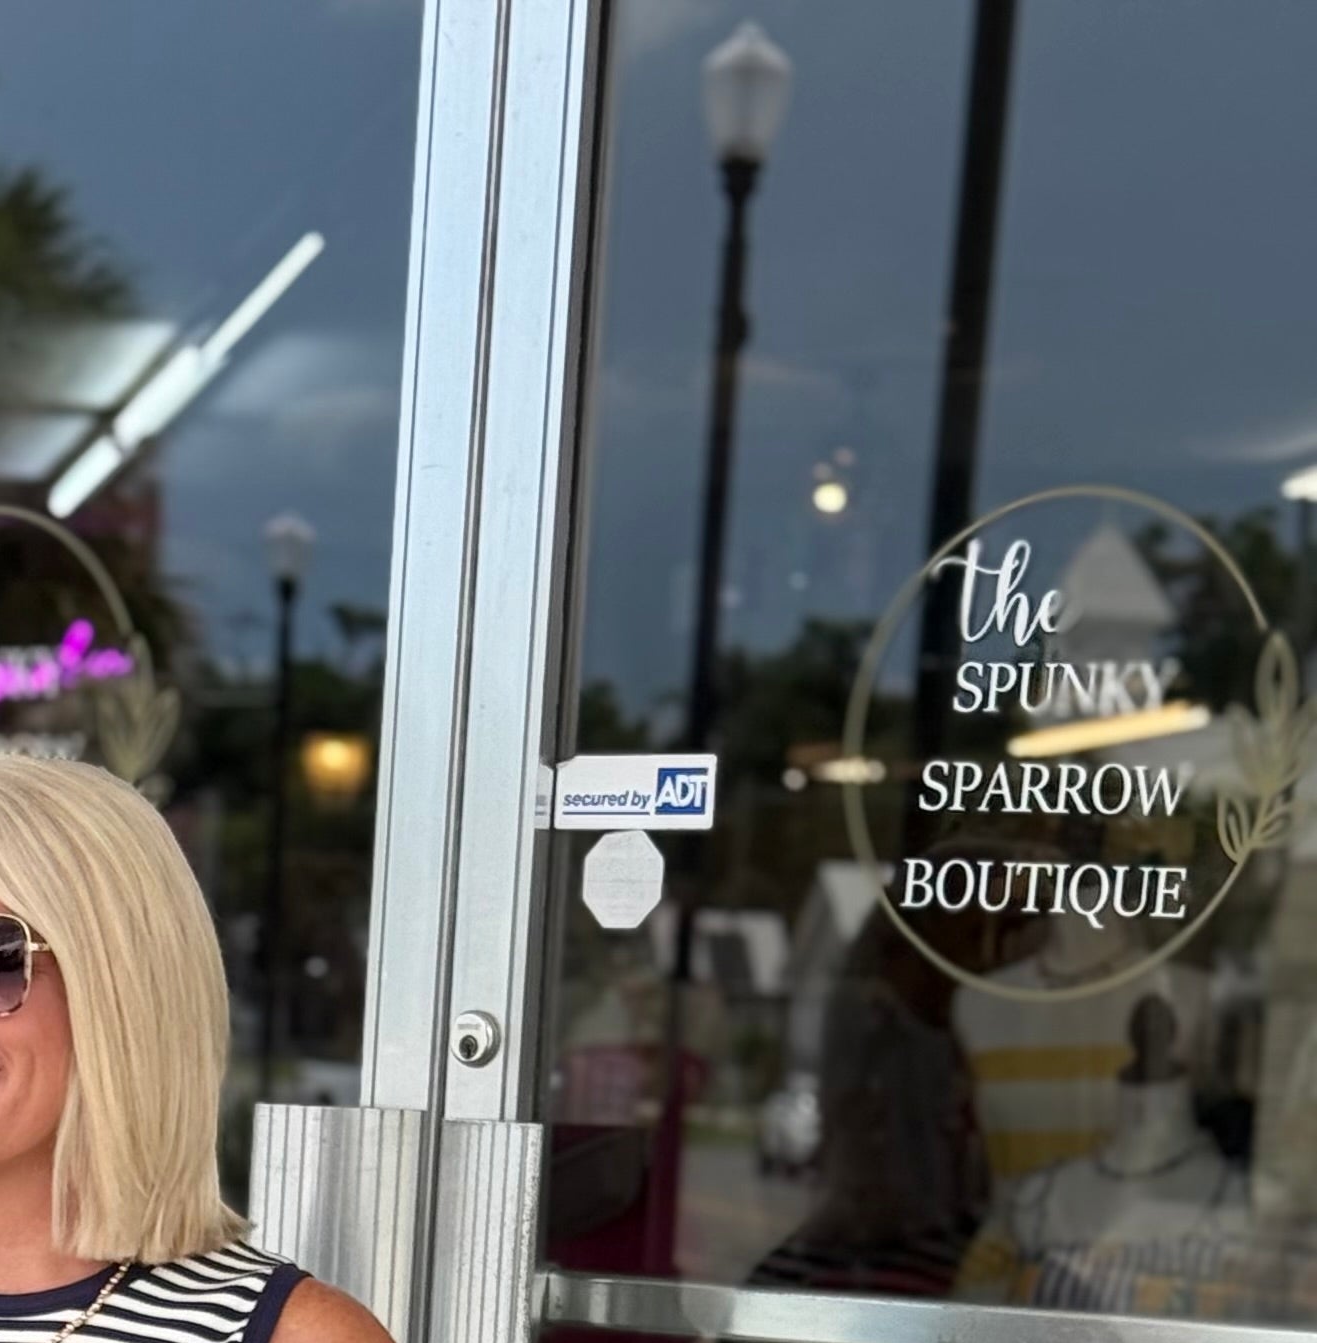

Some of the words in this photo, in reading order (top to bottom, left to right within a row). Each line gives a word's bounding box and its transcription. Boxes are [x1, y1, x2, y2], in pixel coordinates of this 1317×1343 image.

[931, 537, 1065, 647] the
[952, 660, 1181, 714] SPUNKY
[562, 790, 629, 807] secured
[630, 790, 652, 809] by
[655, 774, 709, 808] ADT
[918, 761, 1187, 817] SPARROW
[899, 858, 1188, 930] BOUTIQUE
